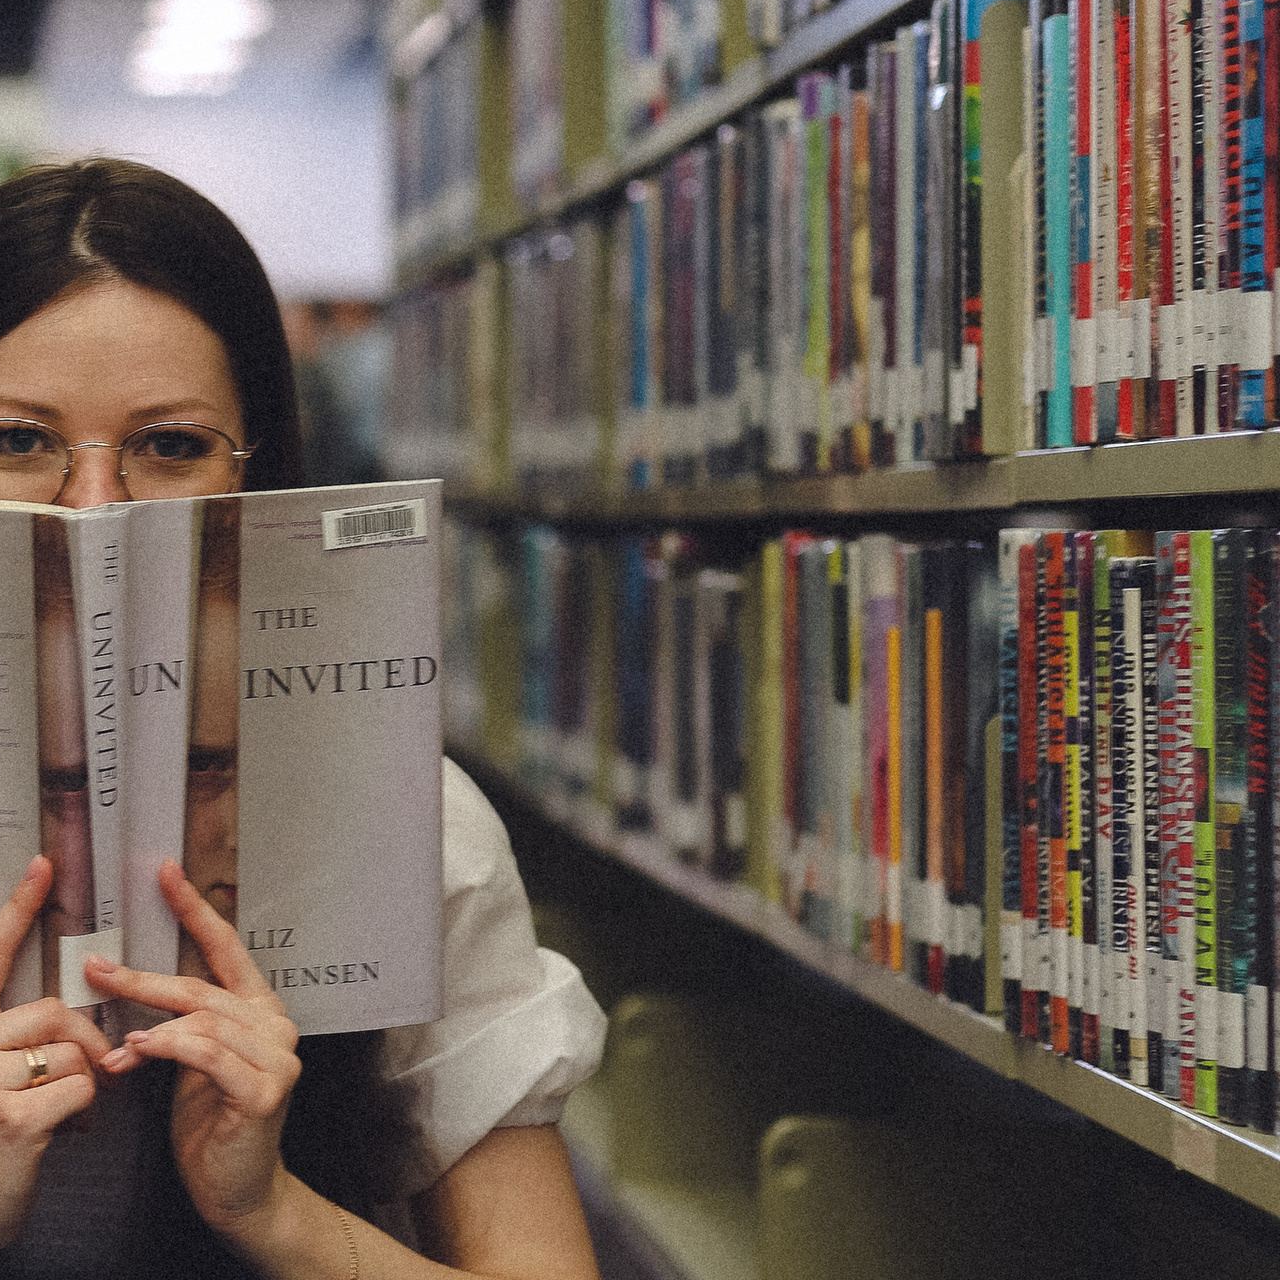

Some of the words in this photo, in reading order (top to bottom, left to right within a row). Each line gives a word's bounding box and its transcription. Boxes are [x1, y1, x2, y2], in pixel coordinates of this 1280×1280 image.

[103, 538, 121, 586] THE
[252, 606, 318, 631] THE
[1173, 574, 1194, 643] IRIS
[127, 657, 184, 698] UN
[243, 654, 439, 700] INVITED
[1095, 609, 1112, 717] NIGHT
[1143, 633, 1157, 686] IRIS
[90, 610, 119, 810] UNINVITED
[1143, 696, 1160, 842] JOHANSEN
[1174, 655, 1196, 843] JOHANSEN
[1097, 776, 1113, 840] DAY
[1158, 696, 1180, 935] JOHANSEN
[247, 927, 297, 951] LIZ
[266, 960, 382, 991] JENSEN
